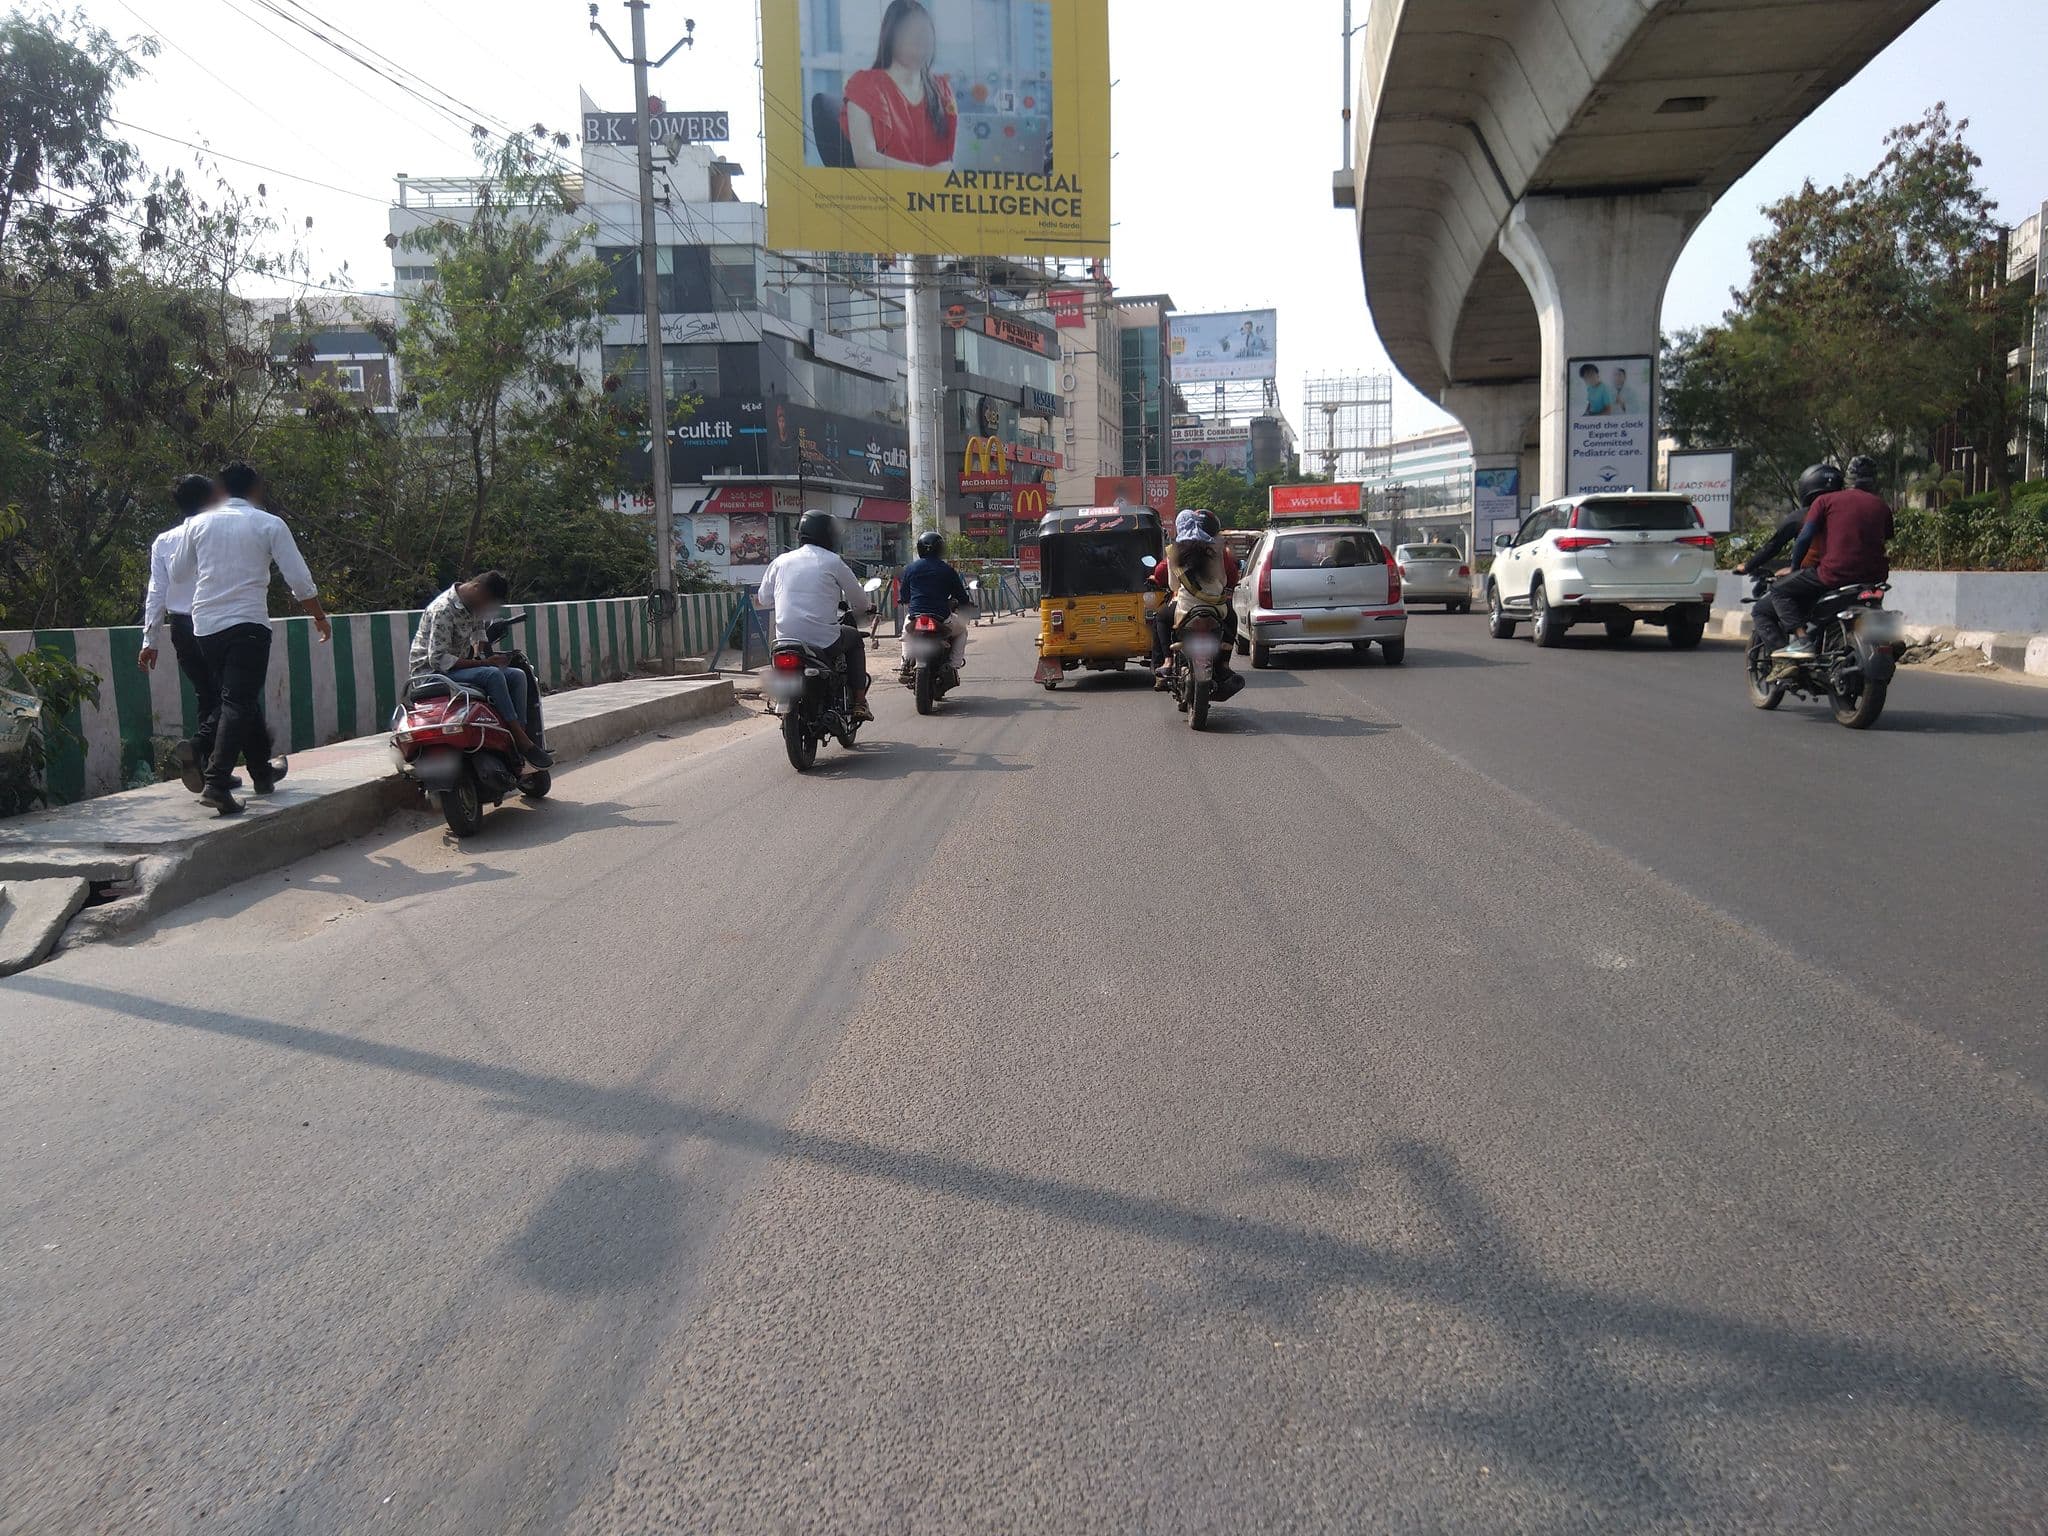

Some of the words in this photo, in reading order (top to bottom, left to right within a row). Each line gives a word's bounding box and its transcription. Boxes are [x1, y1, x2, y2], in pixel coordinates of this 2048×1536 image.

[585, 118, 627, 142] B.K.
[632, 116, 729, 142] OWERS
[944, 169, 1083, 194] ARTIFICIAL
[906, 191, 1083, 218] INTELLIGENCE
[1061, 345, 1076, 471] HOTEL
[678, 421, 733, 438] cult.fit
[1184, 428, 1205, 438] SURE
[1573, 422, 1602, 430] Round
[1620, 421, 1644, 429] clock
[1583, 439, 1633, 447] Committed
[1588, 431, 1618, 439] Expert
[1572, 448, 1617, 457] Pediatric
[1290, 491, 1344, 507] wework
